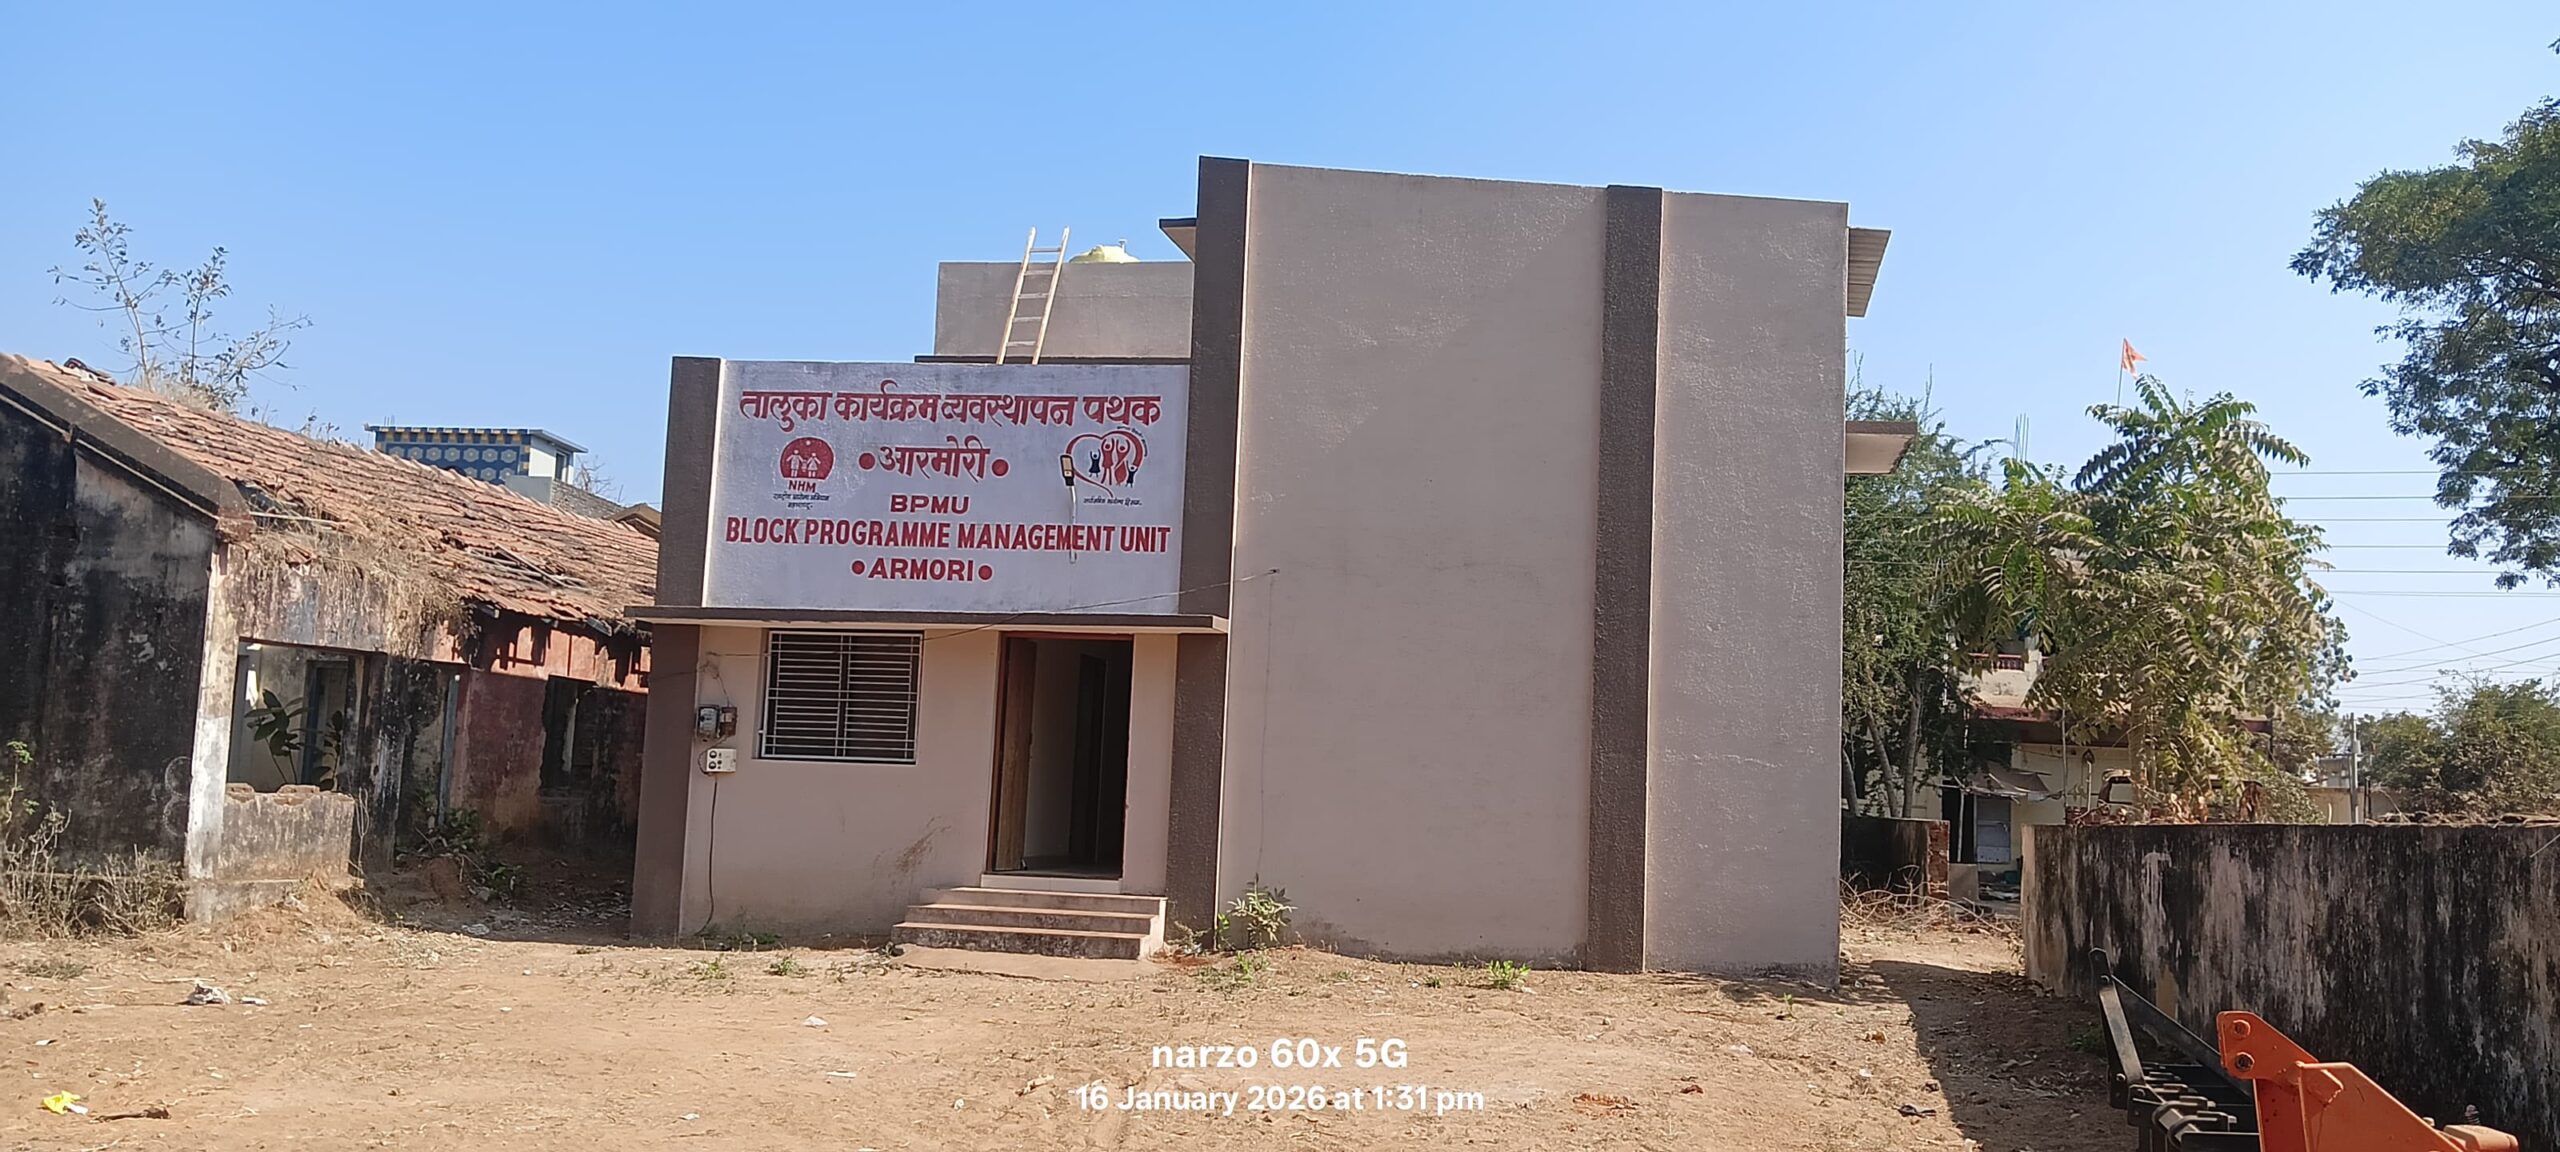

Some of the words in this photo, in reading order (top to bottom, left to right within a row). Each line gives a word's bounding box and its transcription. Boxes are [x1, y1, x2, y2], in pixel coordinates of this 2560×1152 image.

[739, 390, 833, 432] तालुका
[834, 379, 941, 423] कार्यक्रम
[1082, 395, 1162, 426] पथक
[879, 435, 991, 483] आरमोरी
[788, 480, 816, 493] NHM
[890, 495, 970, 514] BPMU
[725, 517, 799, 544] BLOCK
[804, 519, 951, 548] PROGRAMME
[957, 523, 1116, 551] MANAGEMENT
[1120, 526, 1171, 552] UNIT
[868, 558, 974, 581] ARMORI
